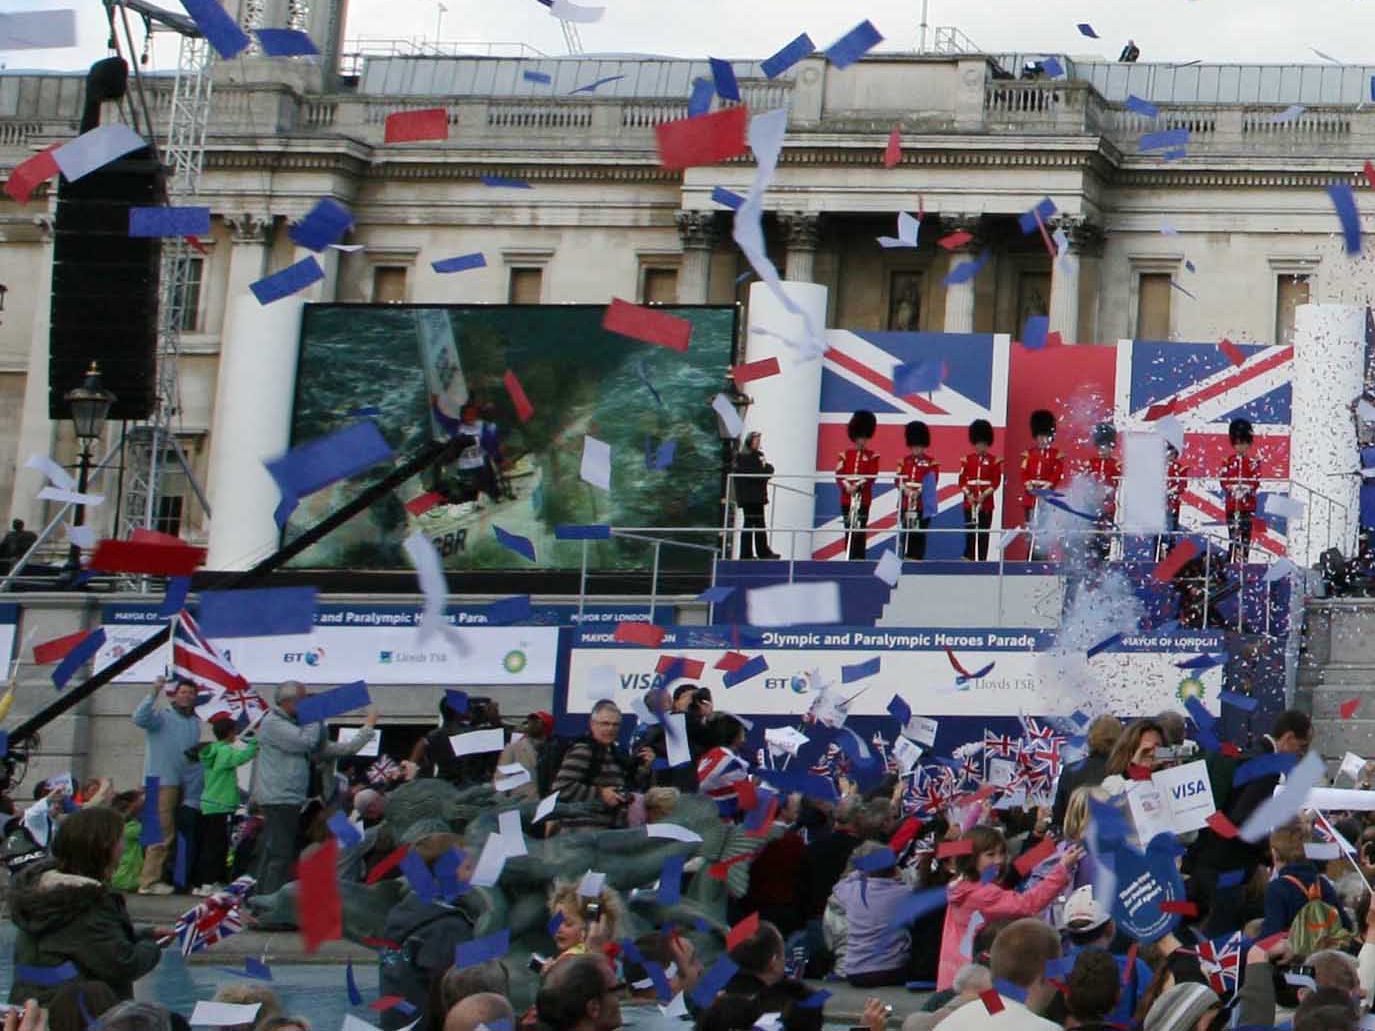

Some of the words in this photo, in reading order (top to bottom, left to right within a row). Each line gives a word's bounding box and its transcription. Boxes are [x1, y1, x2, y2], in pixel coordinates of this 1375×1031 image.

[320, 613, 341, 623] and
[346, 612, 410, 625] Paralympic
[601, 613, 612, 622] OF
[762, 632, 818, 647] Olympic
[824, 633, 849, 645] and
[854, 633, 930, 648] Paralympic
[934, 633, 983, 647] Heroes
[988, 634, 1036, 647] Parade
[284, 652, 303, 663] BT
[621, 673, 661, 690] VISA
[765, 678, 788, 689] BT
[975, 677, 1012, 691] Lloyds
[1172, 779, 1207, 801] VISA
